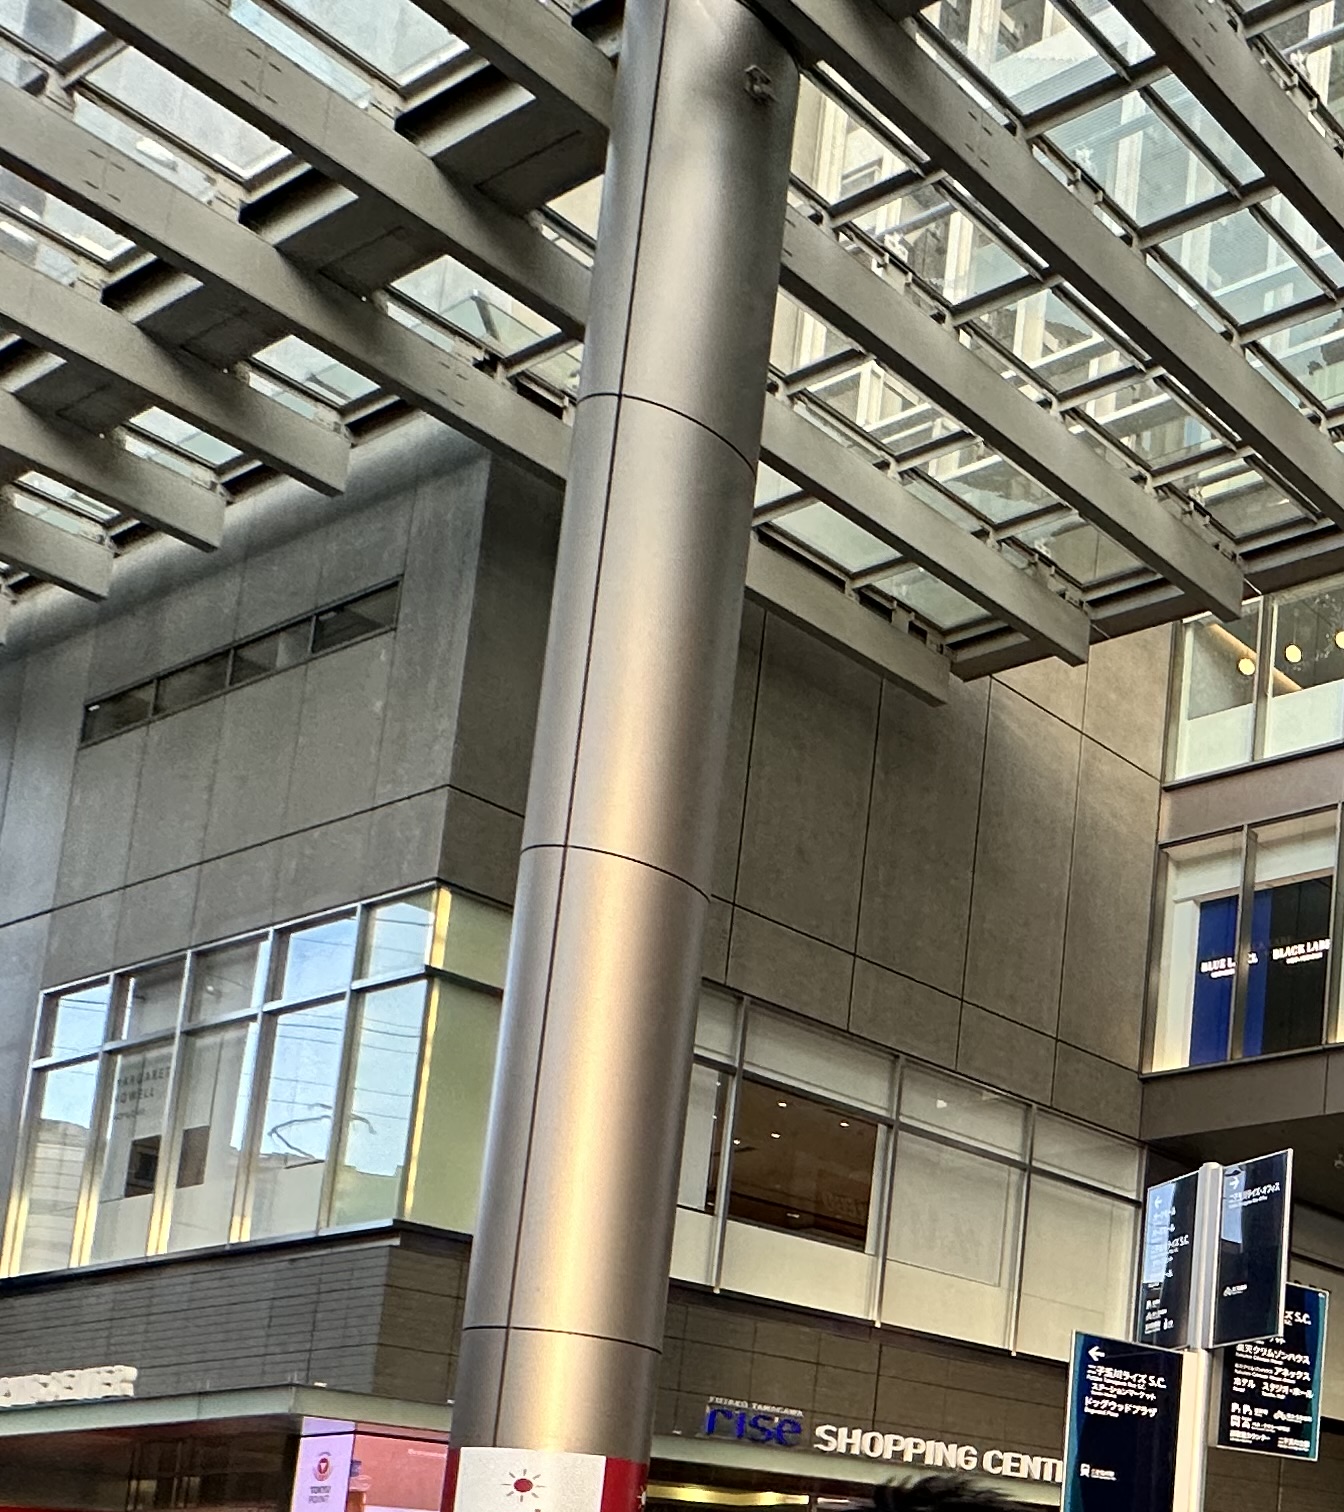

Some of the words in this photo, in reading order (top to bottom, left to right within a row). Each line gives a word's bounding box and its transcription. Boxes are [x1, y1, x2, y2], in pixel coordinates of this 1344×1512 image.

[1272, 944, 1305, 960] BLACK
[1306, 938, 1331, 953] LABE
[705, 1408, 803, 1447] rise
[813, 1424, 978, 1471] SHOPPING
